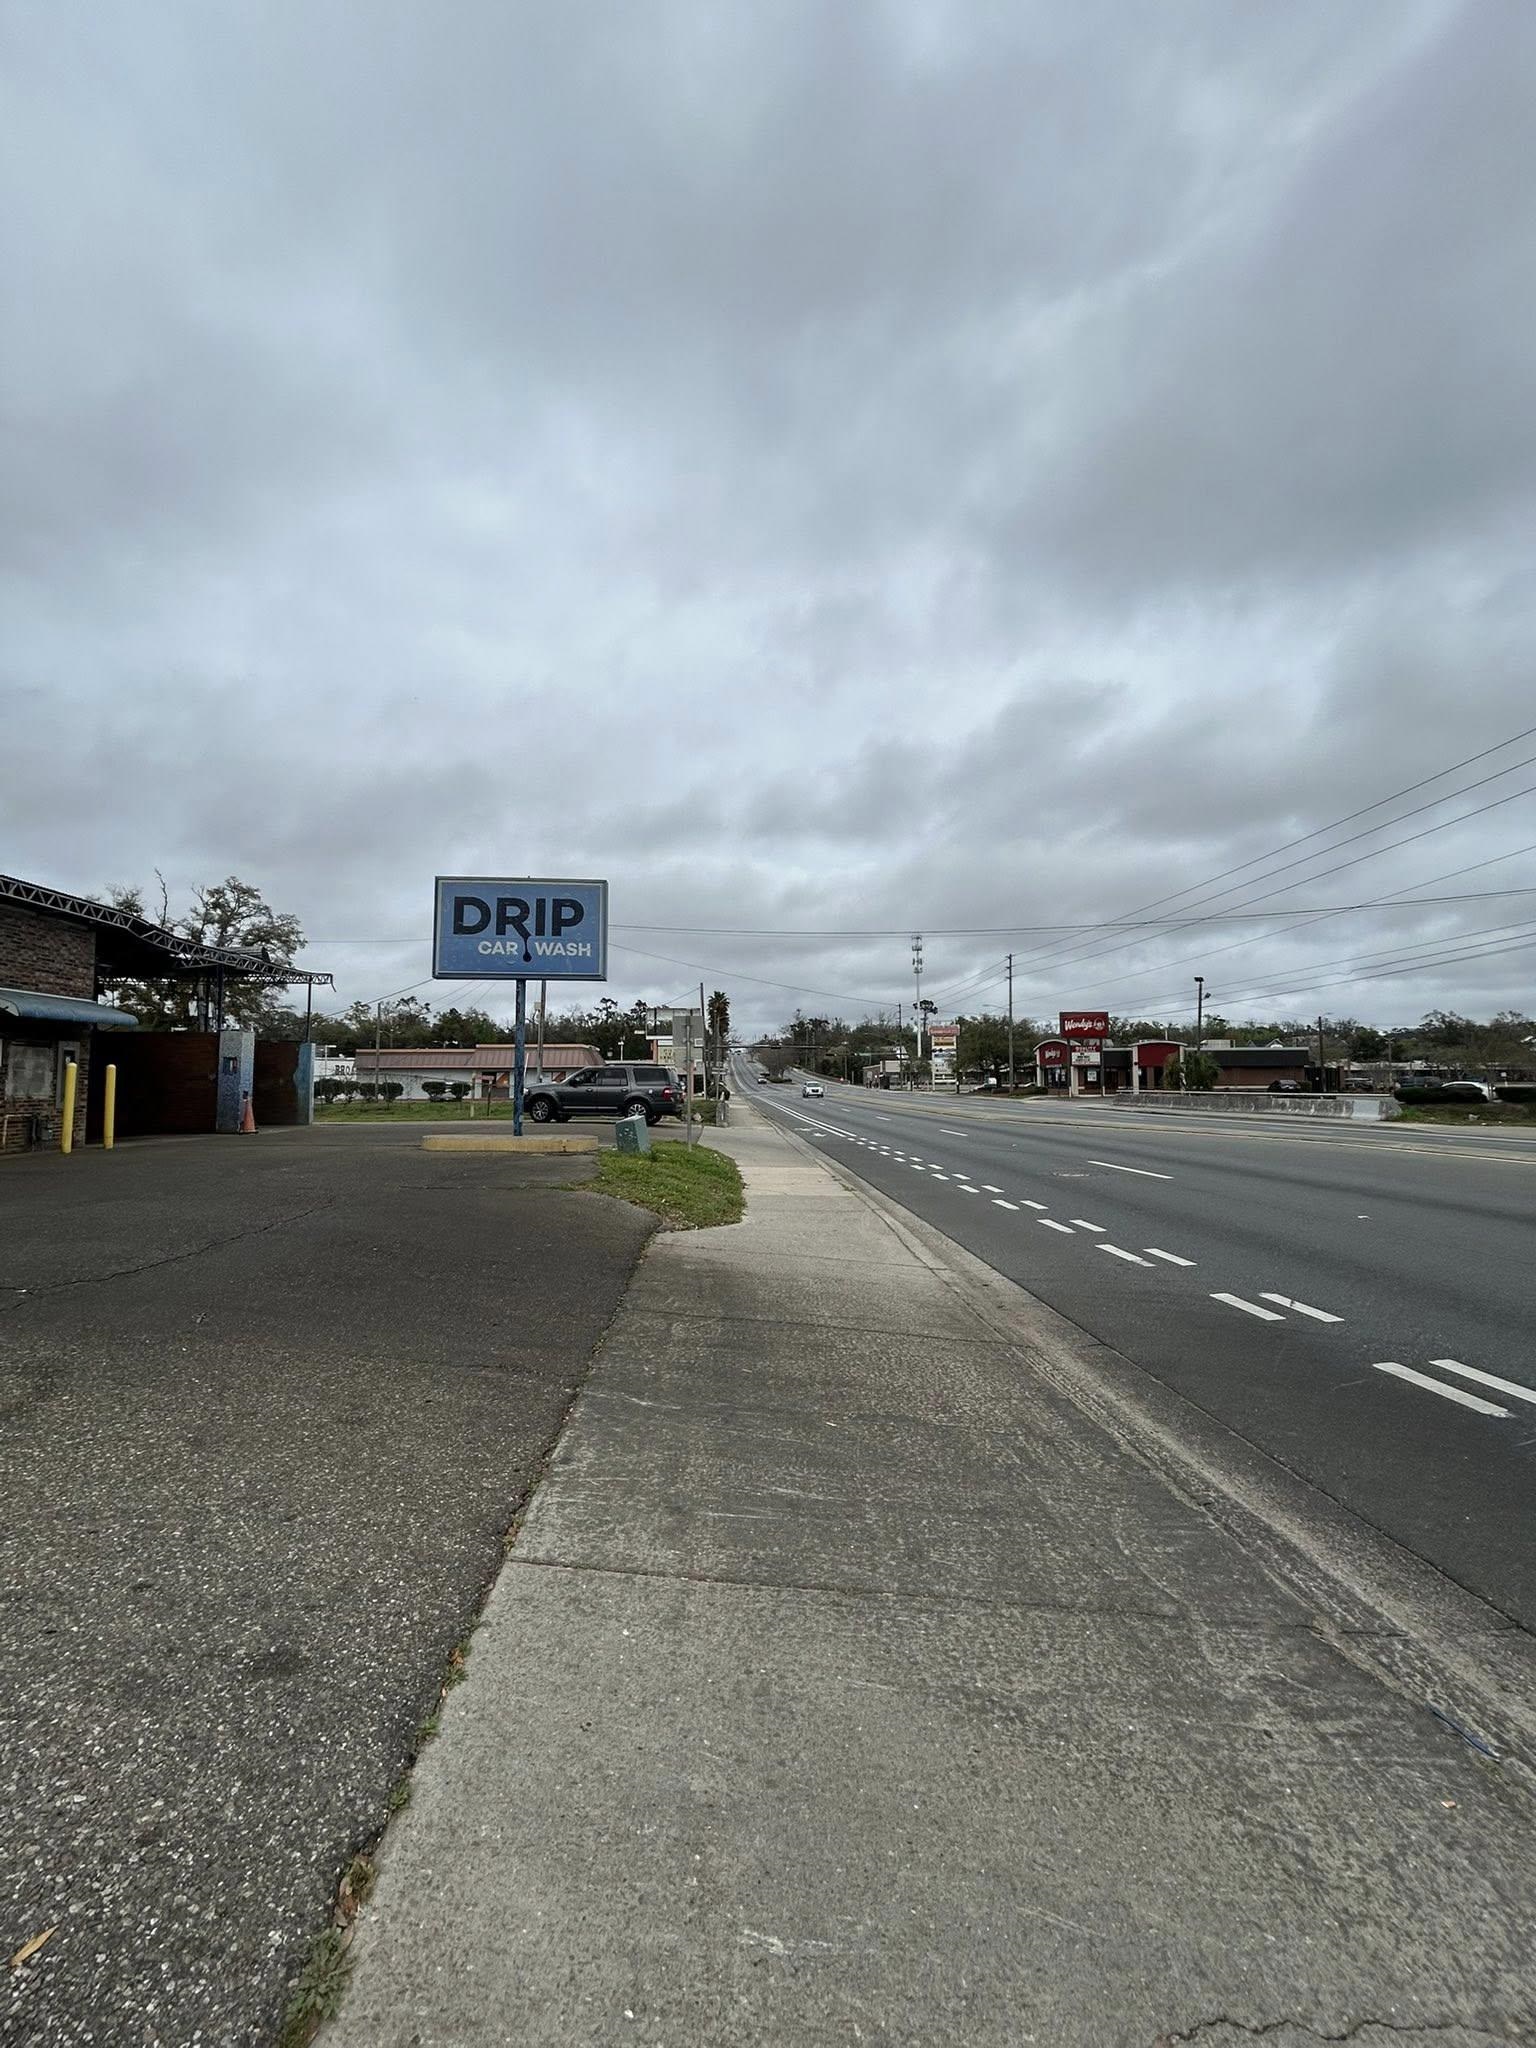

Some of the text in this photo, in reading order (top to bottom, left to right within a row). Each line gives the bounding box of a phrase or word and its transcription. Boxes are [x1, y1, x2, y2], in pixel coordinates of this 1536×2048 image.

[453, 896, 585, 938] DRIP
[477, 941, 592, 957] CAR WASH
[1064, 1018, 1093, 1031] Wendy's
